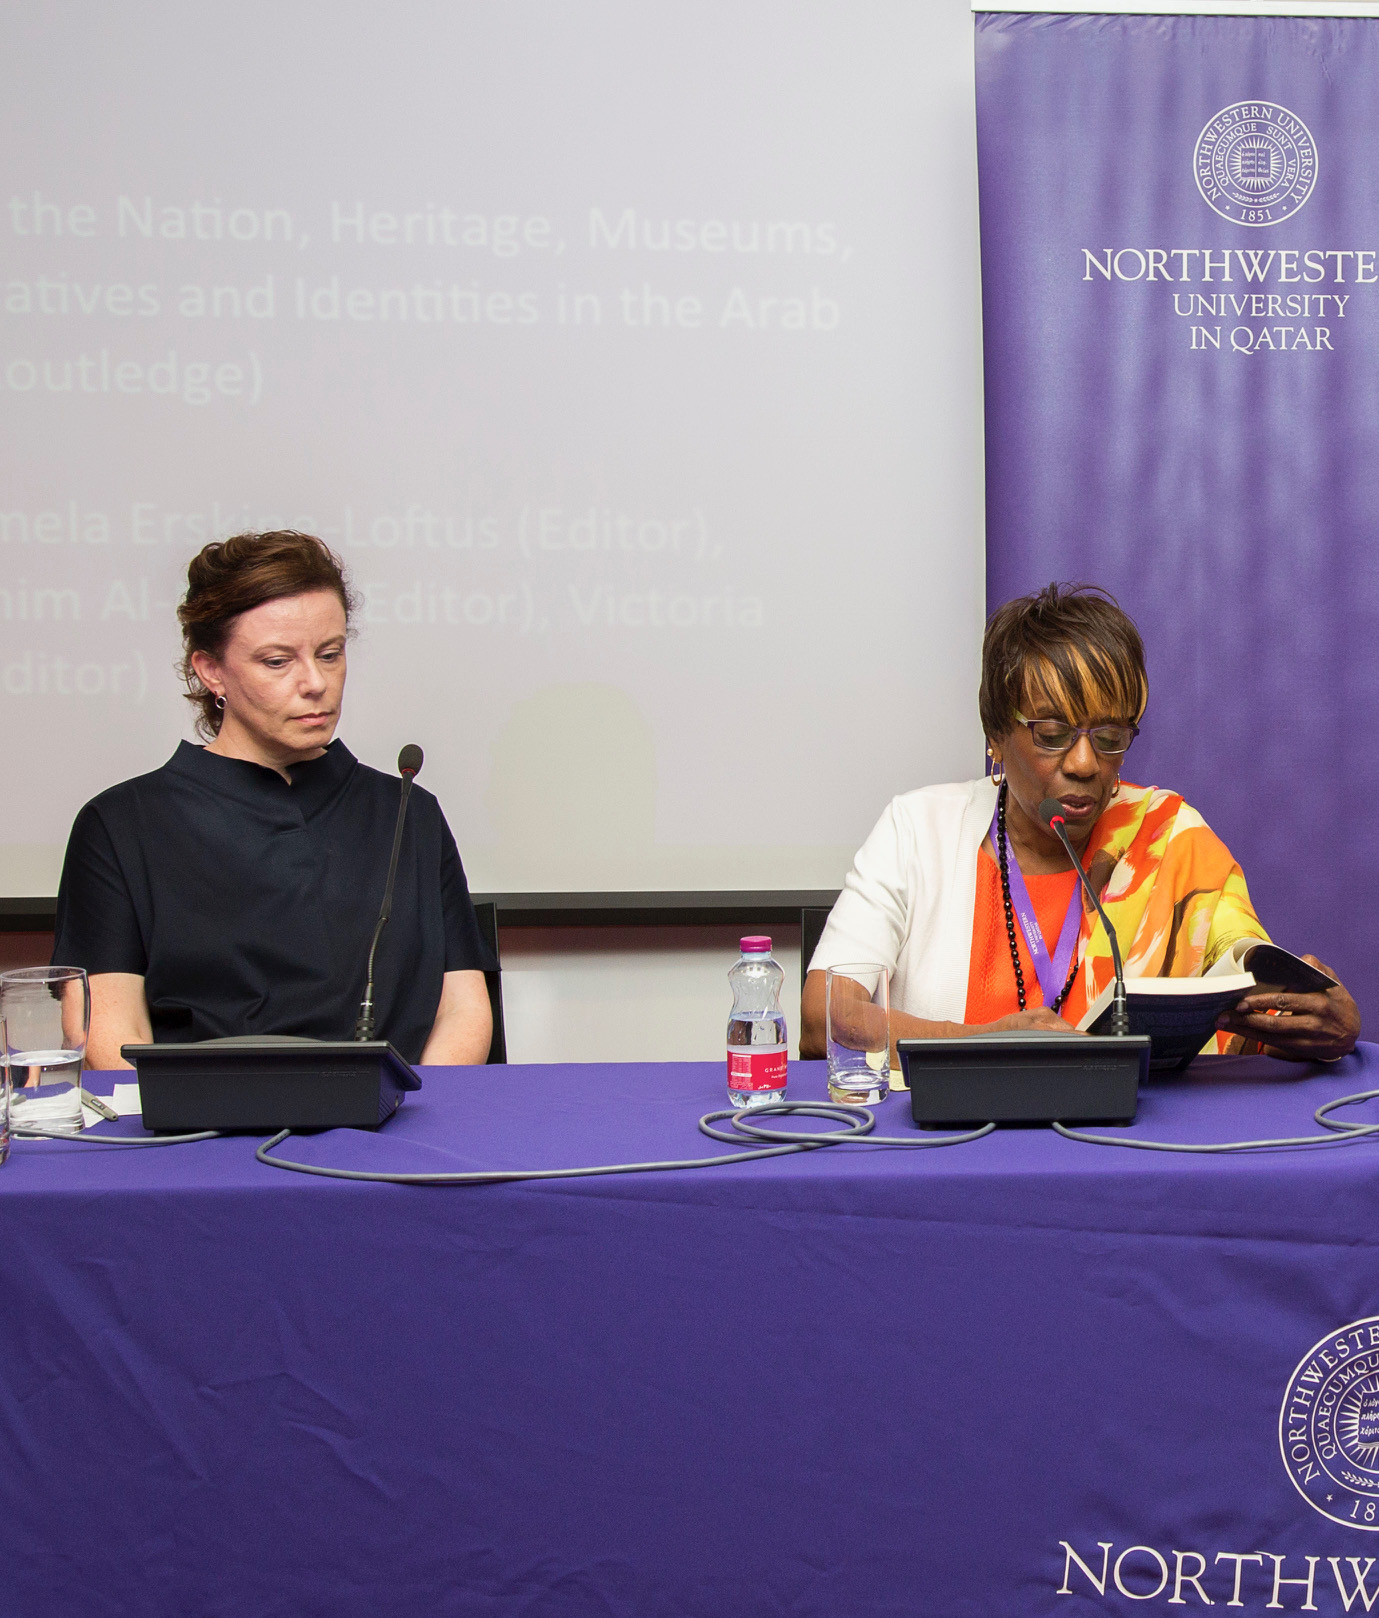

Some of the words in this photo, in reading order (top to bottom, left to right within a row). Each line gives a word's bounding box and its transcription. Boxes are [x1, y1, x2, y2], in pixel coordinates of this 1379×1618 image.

[1199, 106, 1273, 201] NORTHWESTERN
[1278, 113, 1313, 204] UNIVERSITY
[1216, 123, 1257, 186] QUAECUMQUE
[1266, 126, 1292, 150] SUNT
[1281, 159, 1296, 188] VERA
[8, 190, 98, 237] the
[116, 194, 310, 250] Nation,
[330, 200, 567, 259] Heritage,
[588, 206, 855, 264] Museums,
[1240, 209, 1272, 222] 1851
[0, 270, 161, 316] atives
[178, 273, 276, 319] and
[296, 274, 540, 325] Identities
[557, 281, 601, 325] in
[620, 281, 704, 328] the
[718, 285, 840, 332] Arab
[1172, 293, 1350, 317] UNIVERSITY
[1189, 326, 1222, 350] IN
[1230, 326, 1334, 355] QATAR
[0, 347, 264, 407] outledge)
[517, 503, 723, 562] (Editor),
[568, 583, 765, 628] Victoria
